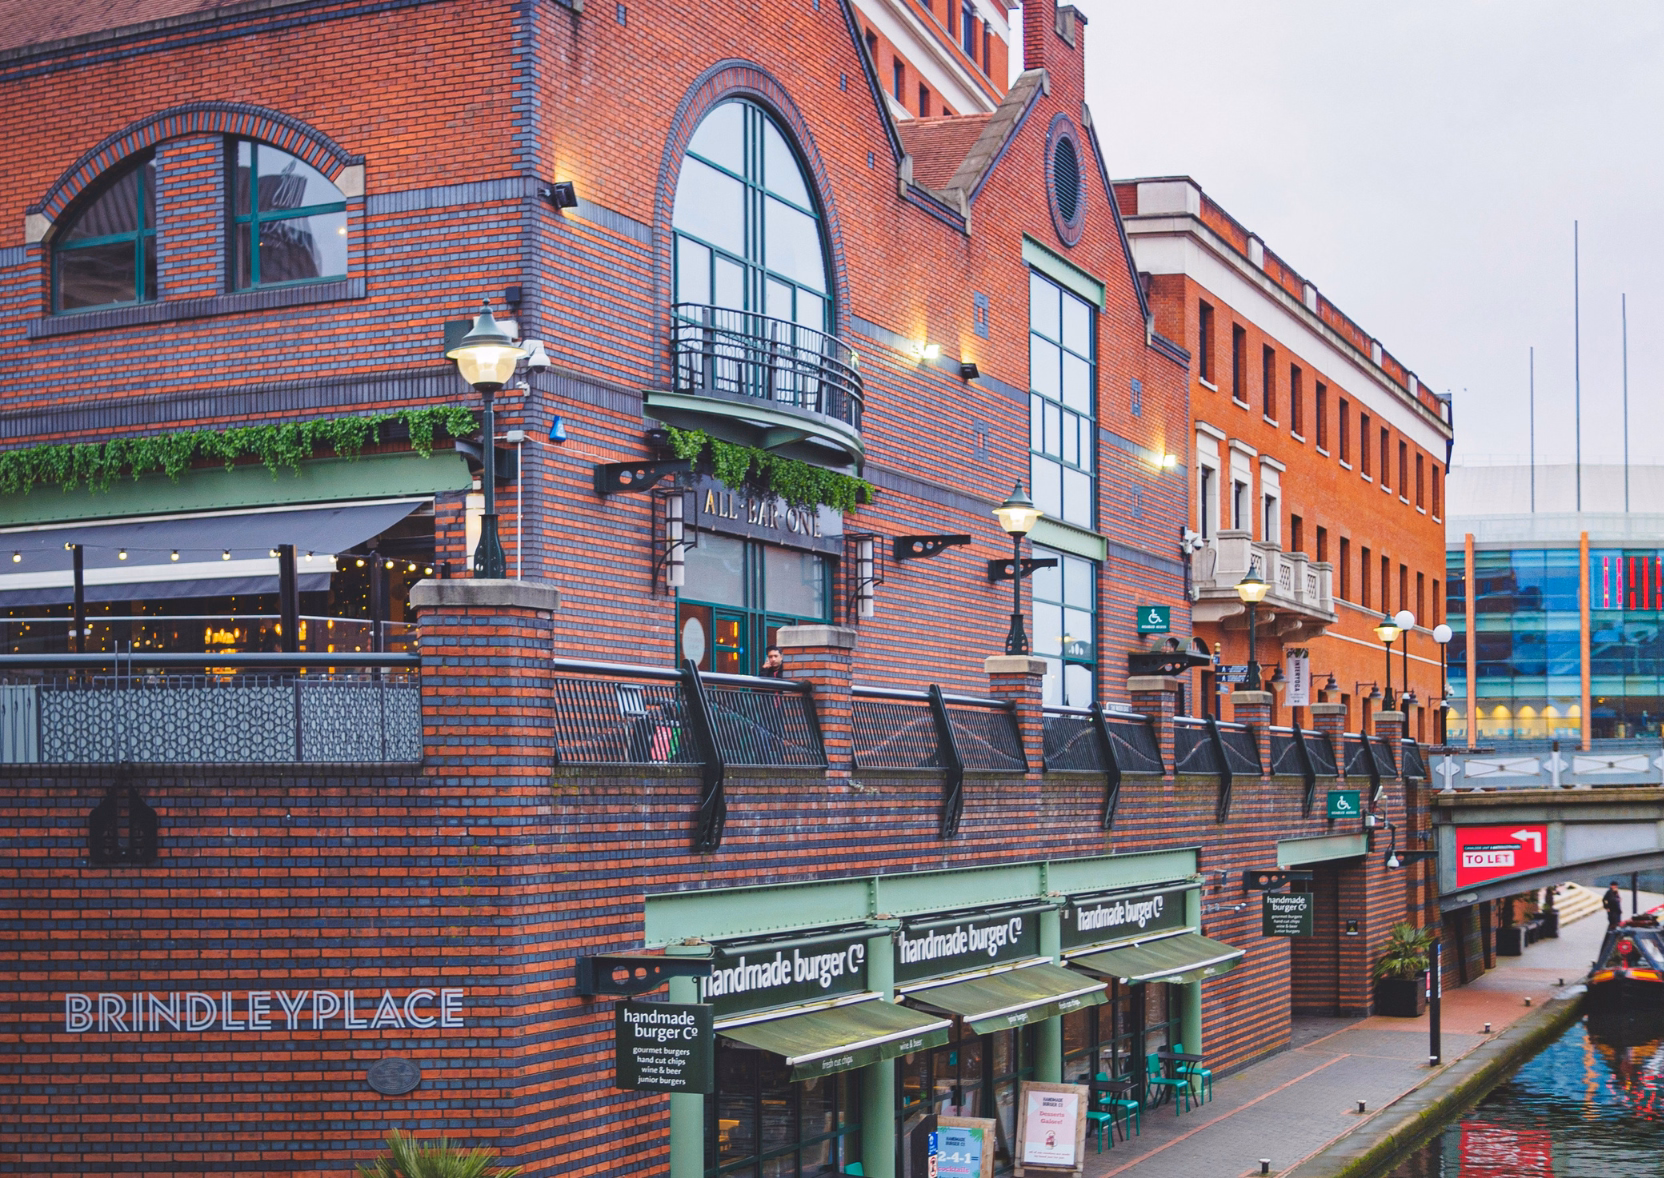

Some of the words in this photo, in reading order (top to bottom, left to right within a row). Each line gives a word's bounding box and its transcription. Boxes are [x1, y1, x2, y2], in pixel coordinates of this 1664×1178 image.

[704, 488, 738, 519] ALL
[747, 497, 778, 530] BAR
[786, 507, 822, 538] ONE
[1465, 854, 1484, 864] TO
[1487, 853, 1511, 864] LET
[1266, 896, 1306, 904] handmade
[1272, 903, 1297, 913] burger
[1077, 902, 1125, 931] handmade
[1125, 900, 1153, 928] burger
[900, 926, 967, 964] handmade
[968, 923, 1008, 957] burger
[702, 951, 791, 998] handmade
[794, 948, 847, 988] burger
[65, 988, 465, 1032] BRINDLEYPLACE
[624, 1008, 695, 1025] handmade
[635, 1023, 681, 1042] burger
[633, 1047, 662, 1055] gourmet
[663, 1047, 690, 1057] burgers
[637, 1056, 654, 1064] hand
[667, 1056, 686, 1066] chips
[658, 1066, 665, 1074] &
[666, 1066, 681, 1075] beer
[637, 1075, 658, 1084] junior
[659, 1076, 686, 1086] burgers
